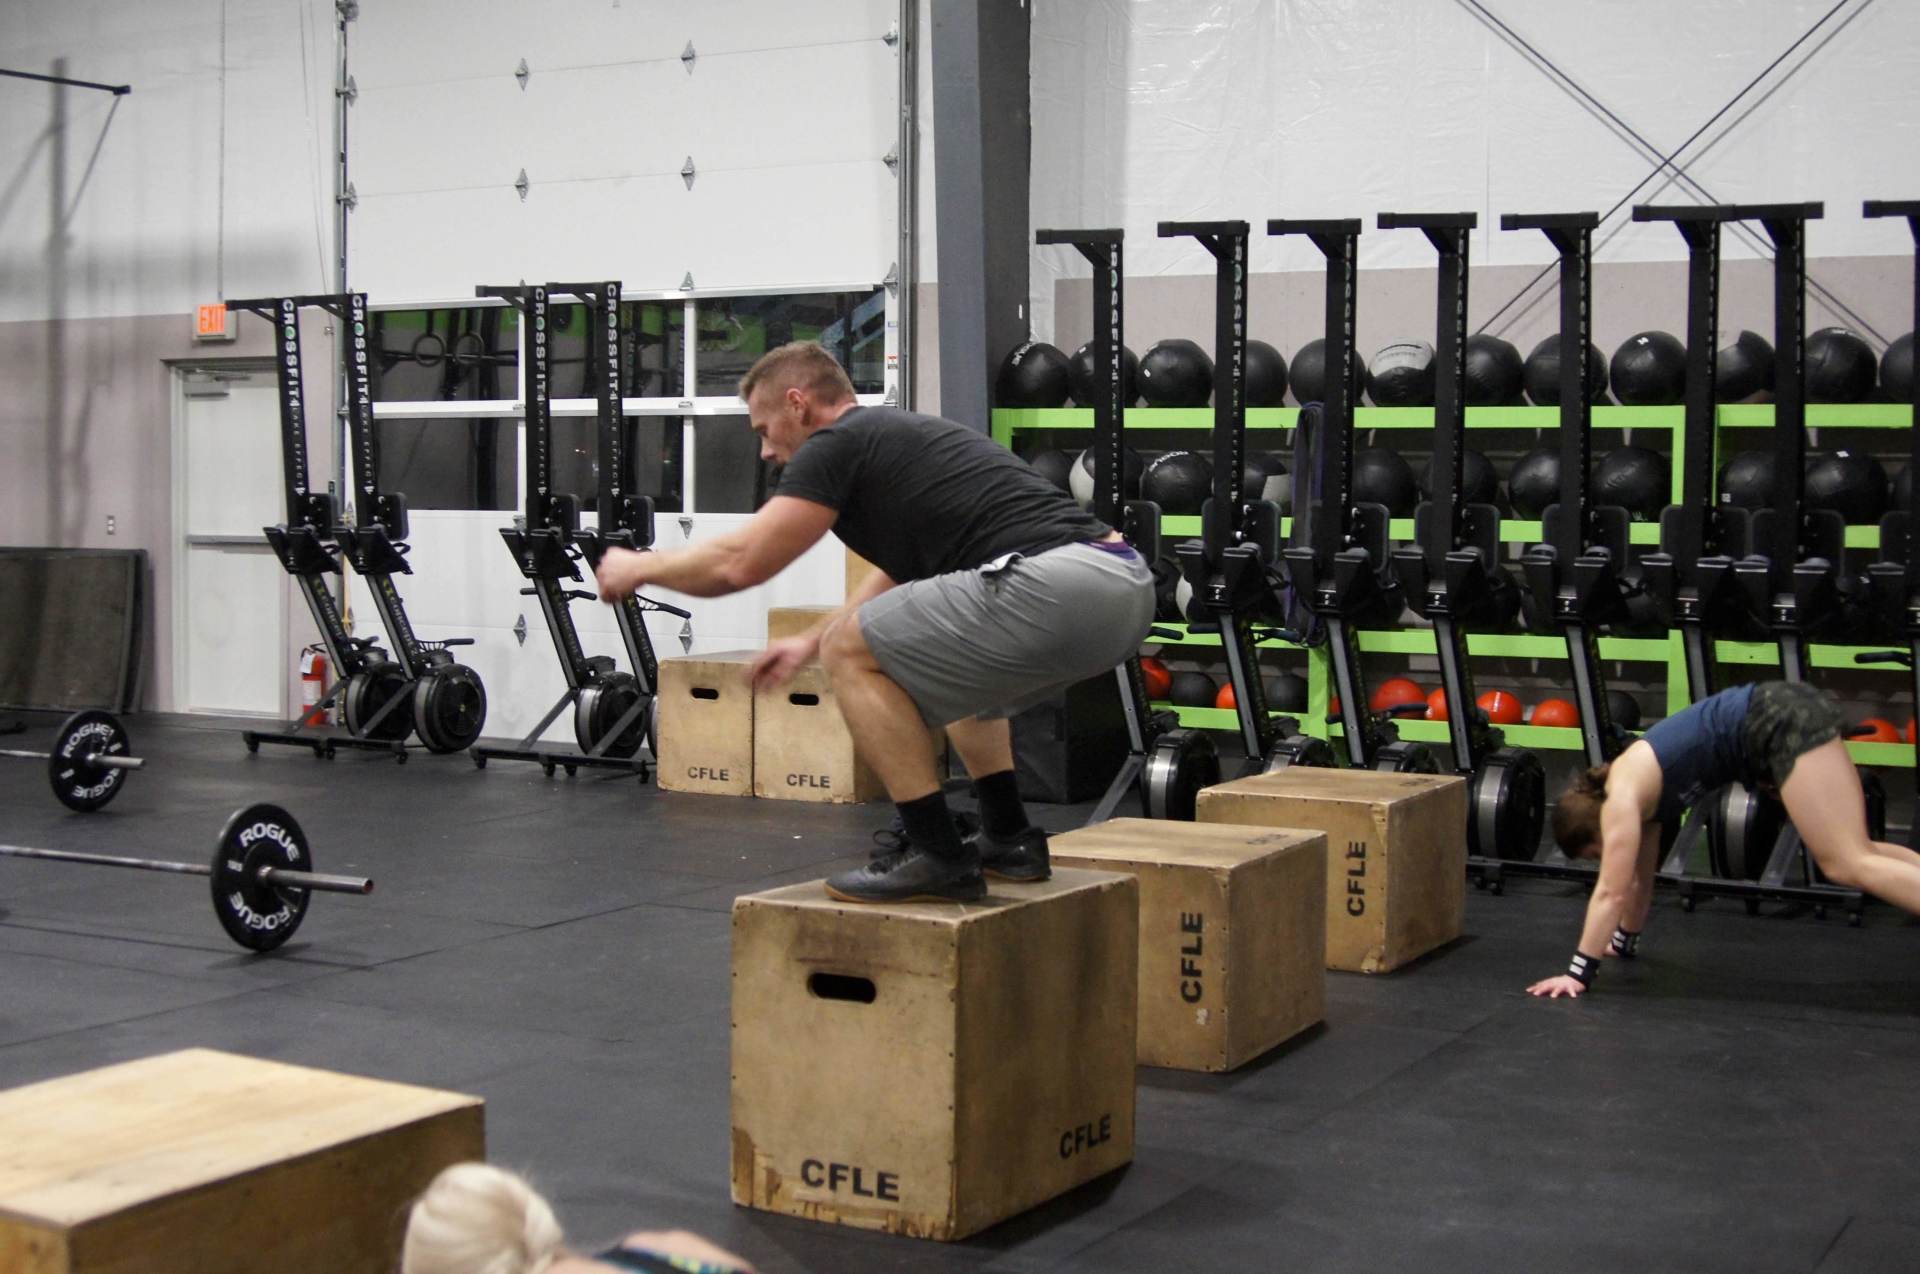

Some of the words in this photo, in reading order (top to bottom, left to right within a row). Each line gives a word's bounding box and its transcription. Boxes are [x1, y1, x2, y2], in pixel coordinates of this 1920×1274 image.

[199, 305, 225, 333] EXIT
[535, 287, 546, 396] CROSSFIT
[607, 283, 618, 394] CROSSFIT
[283, 299, 300, 401] CROSSFIT
[352, 295, 369, 399] CROSSFIT
[62, 723, 111, 758] ROGUE
[687, 766, 730, 782] CFLE
[786, 773, 831, 789] CFLE
[240, 823, 300, 862] ROGUE
[1346, 841, 1367, 917] CFLE
[229, 892, 291, 930] ROGUE
[1180, 912, 1204, 1004] CFLE
[1058, 1113, 1112, 1160] CFLE
[801, 1158, 900, 1202] CFLE
